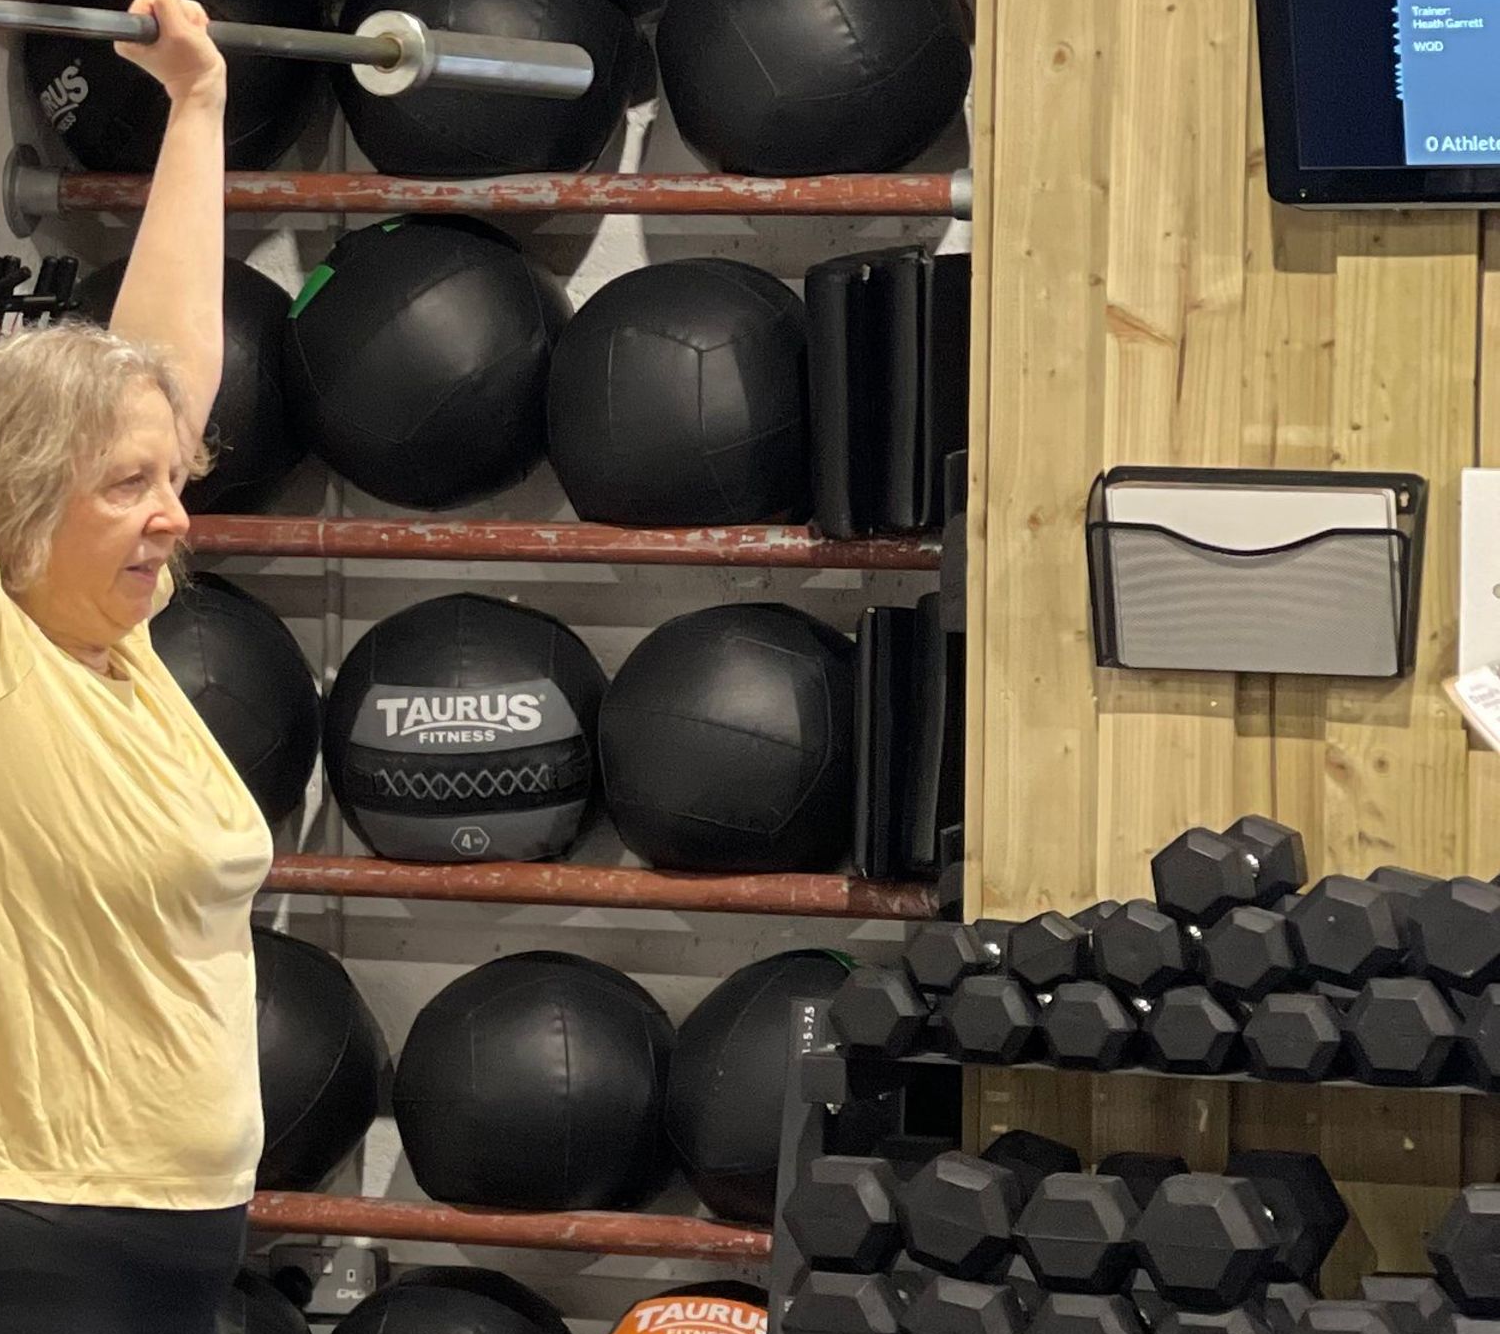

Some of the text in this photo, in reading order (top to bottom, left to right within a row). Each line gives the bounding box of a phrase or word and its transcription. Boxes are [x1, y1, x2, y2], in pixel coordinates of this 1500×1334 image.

[1412, 40, 1444, 52] WOD
[1426, 135, 1439, 153] 0
[376, 693, 543, 737] TAURUS
[418, 729, 496, 744] FITNESS
